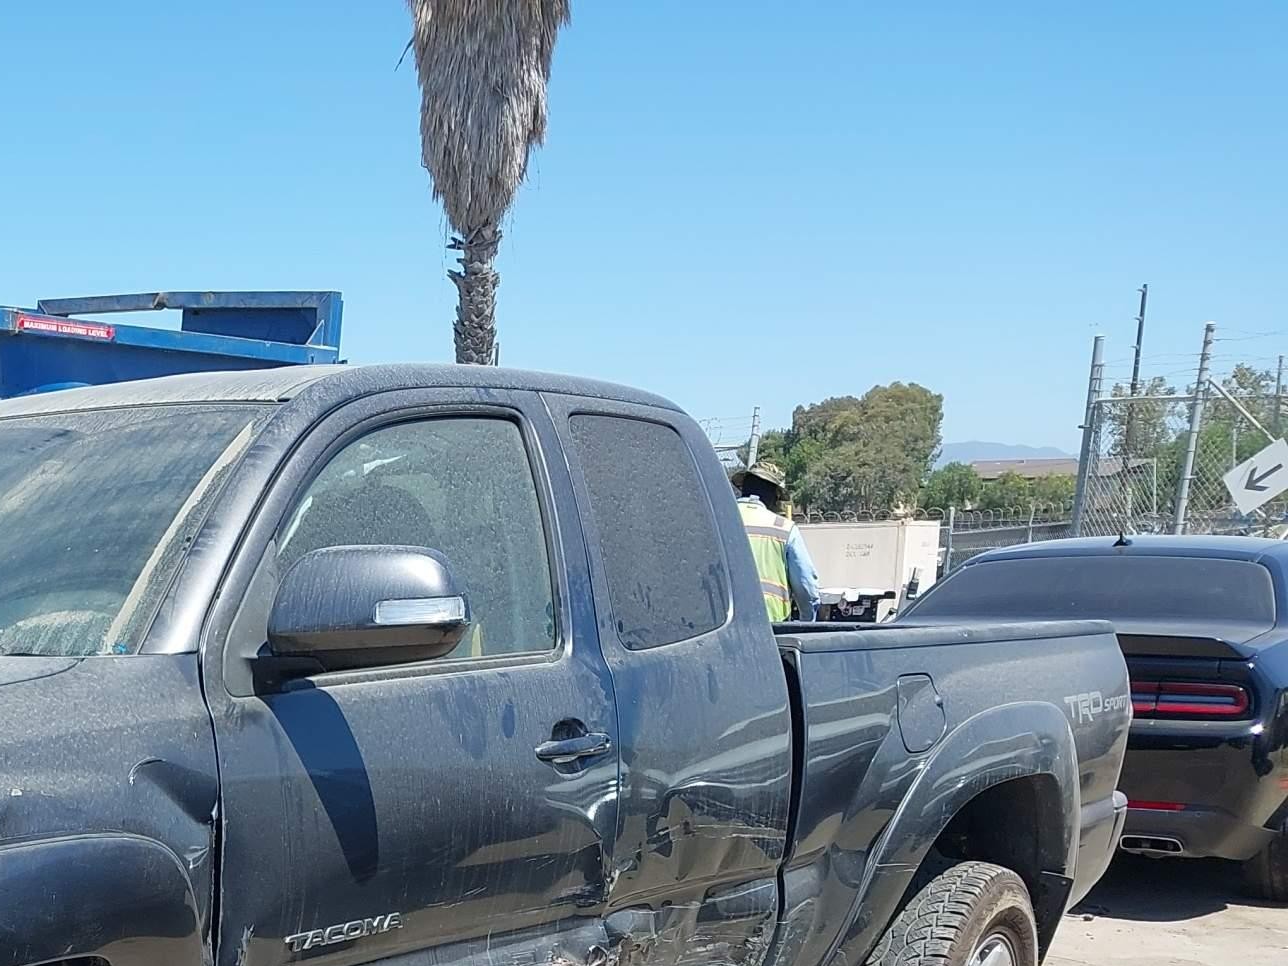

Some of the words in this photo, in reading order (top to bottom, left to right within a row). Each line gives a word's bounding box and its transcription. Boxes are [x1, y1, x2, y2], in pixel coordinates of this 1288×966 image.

[23, 321, 57, 332] MAXIMUM
[58, 326, 87, 335] LOADING
[88, 330, 108, 338] LEVEL
[1064, 691, 1103, 724] TRD
[1104, 694, 1129, 716] SPORT
[285, 912, 404, 952] TACOMA
